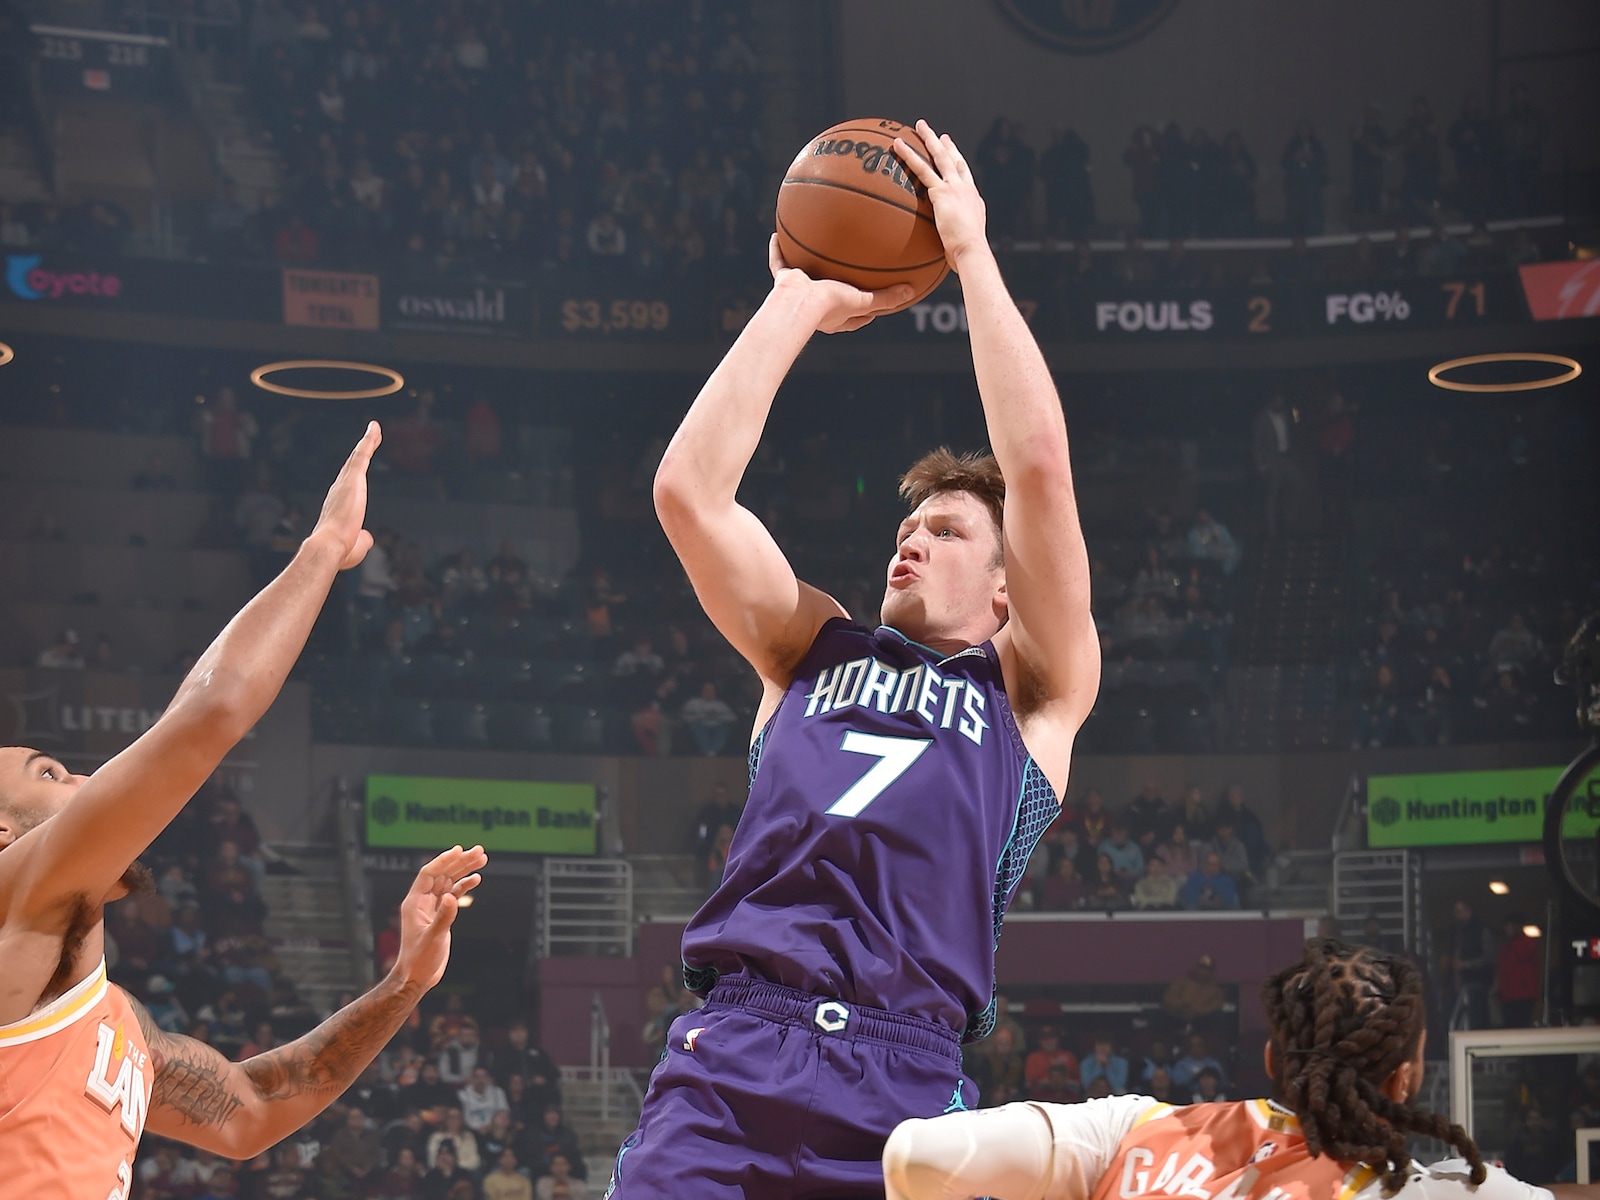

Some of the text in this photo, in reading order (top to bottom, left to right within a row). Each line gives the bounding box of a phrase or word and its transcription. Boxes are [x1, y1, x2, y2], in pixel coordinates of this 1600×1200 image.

[307, 302, 355, 324] TOTAL
[398, 288, 505, 321] oswald
[561, 300, 669, 334] $3,599
[1096, 299, 1271, 331] FOULS 2
[1326, 283, 1486, 325] FG% 71
[803, 655, 990, 747] HORNETS
[823, 729, 935, 819] 7
[404, 801, 593, 831] Huntington Bank
[1405, 797, 1537, 823] Huntington
[127, 1039, 147, 1069] THE
